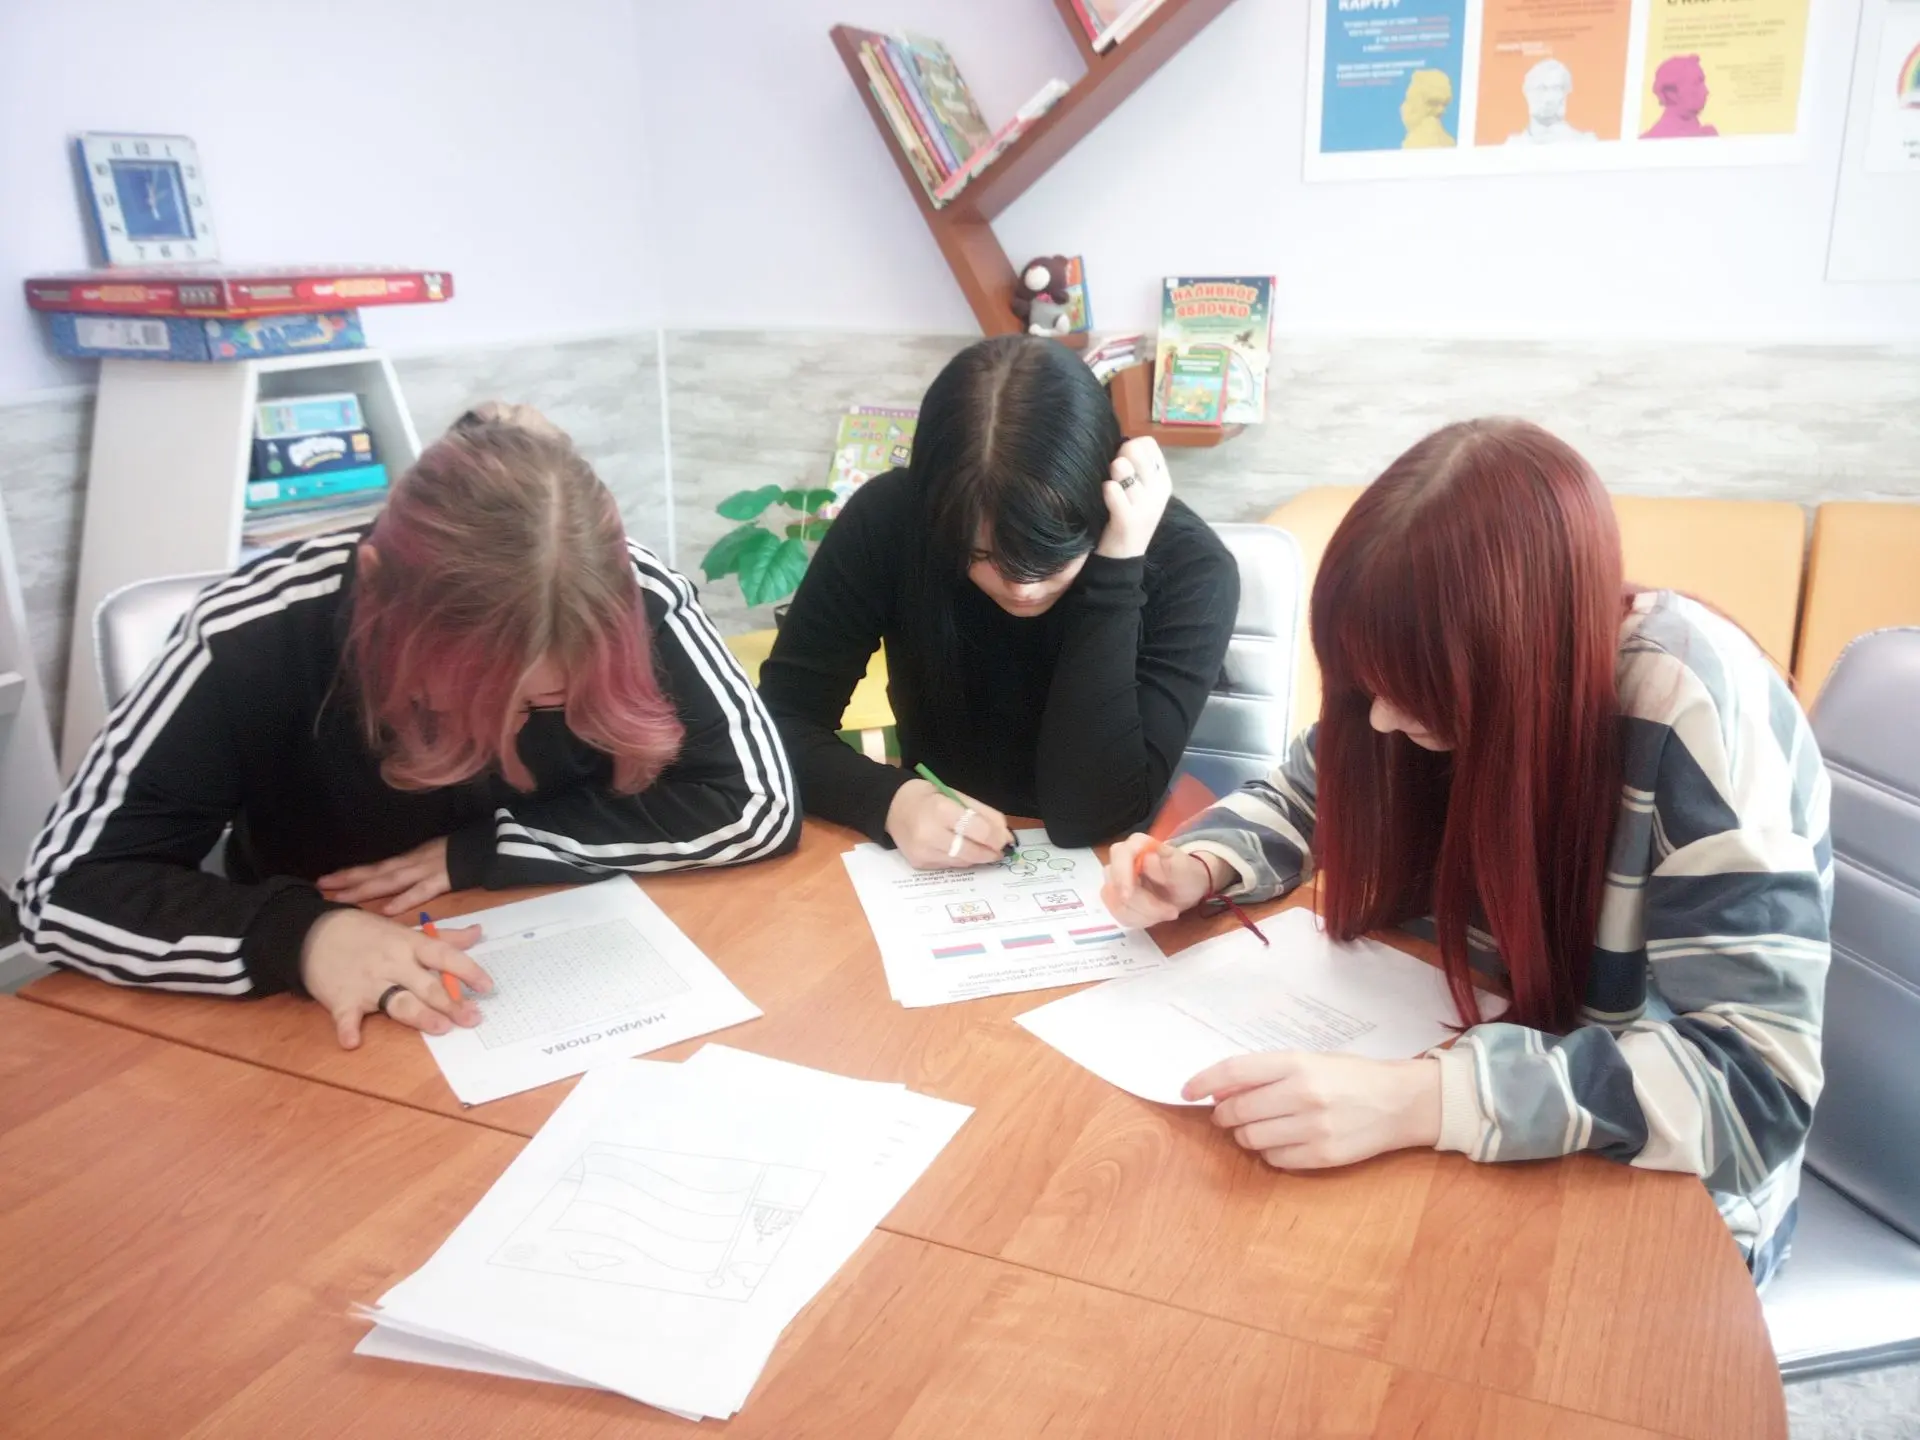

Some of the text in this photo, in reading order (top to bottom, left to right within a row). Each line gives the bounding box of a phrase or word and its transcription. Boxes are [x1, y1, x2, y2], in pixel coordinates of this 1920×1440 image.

[1173, 285, 1256, 301] НАЛИВНОЕ
[1177, 302, 1248, 317] ЯБЛОЧКО
[541, 1033, 602, 1055] СЛОВА
